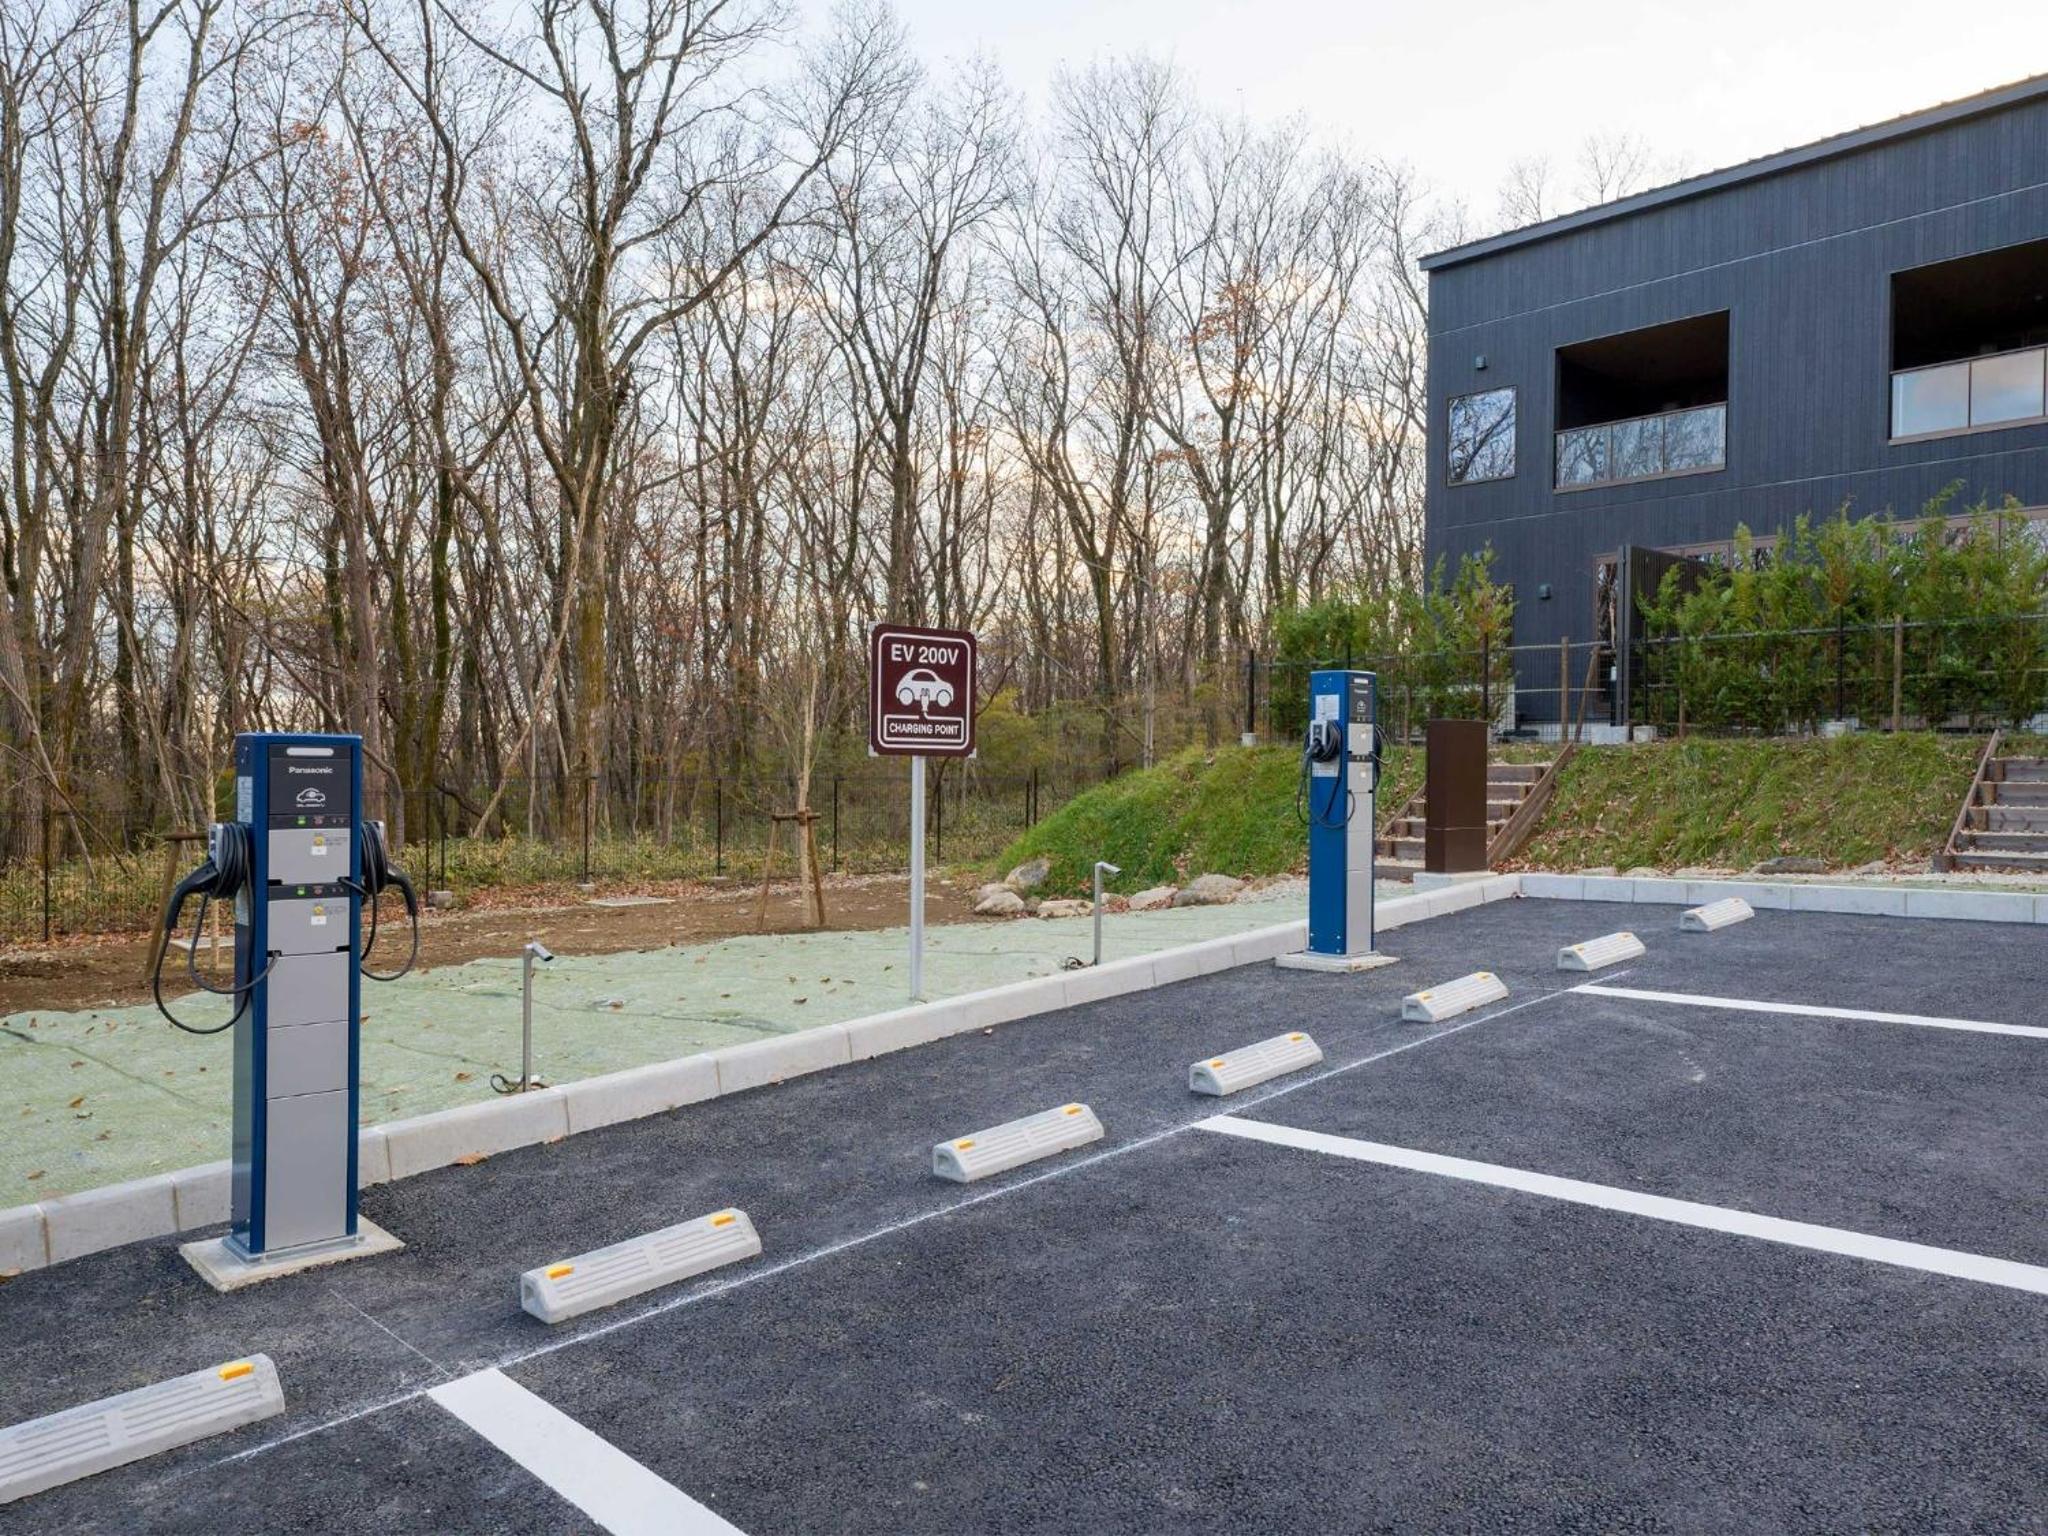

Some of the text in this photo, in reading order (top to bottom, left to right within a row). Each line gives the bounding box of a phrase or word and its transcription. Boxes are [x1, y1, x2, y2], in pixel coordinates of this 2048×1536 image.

[891, 643, 959, 666] EV 200V
[889, 722, 960, 735] CHARGING POINT
[288, 766, 333, 774] Panasonic
